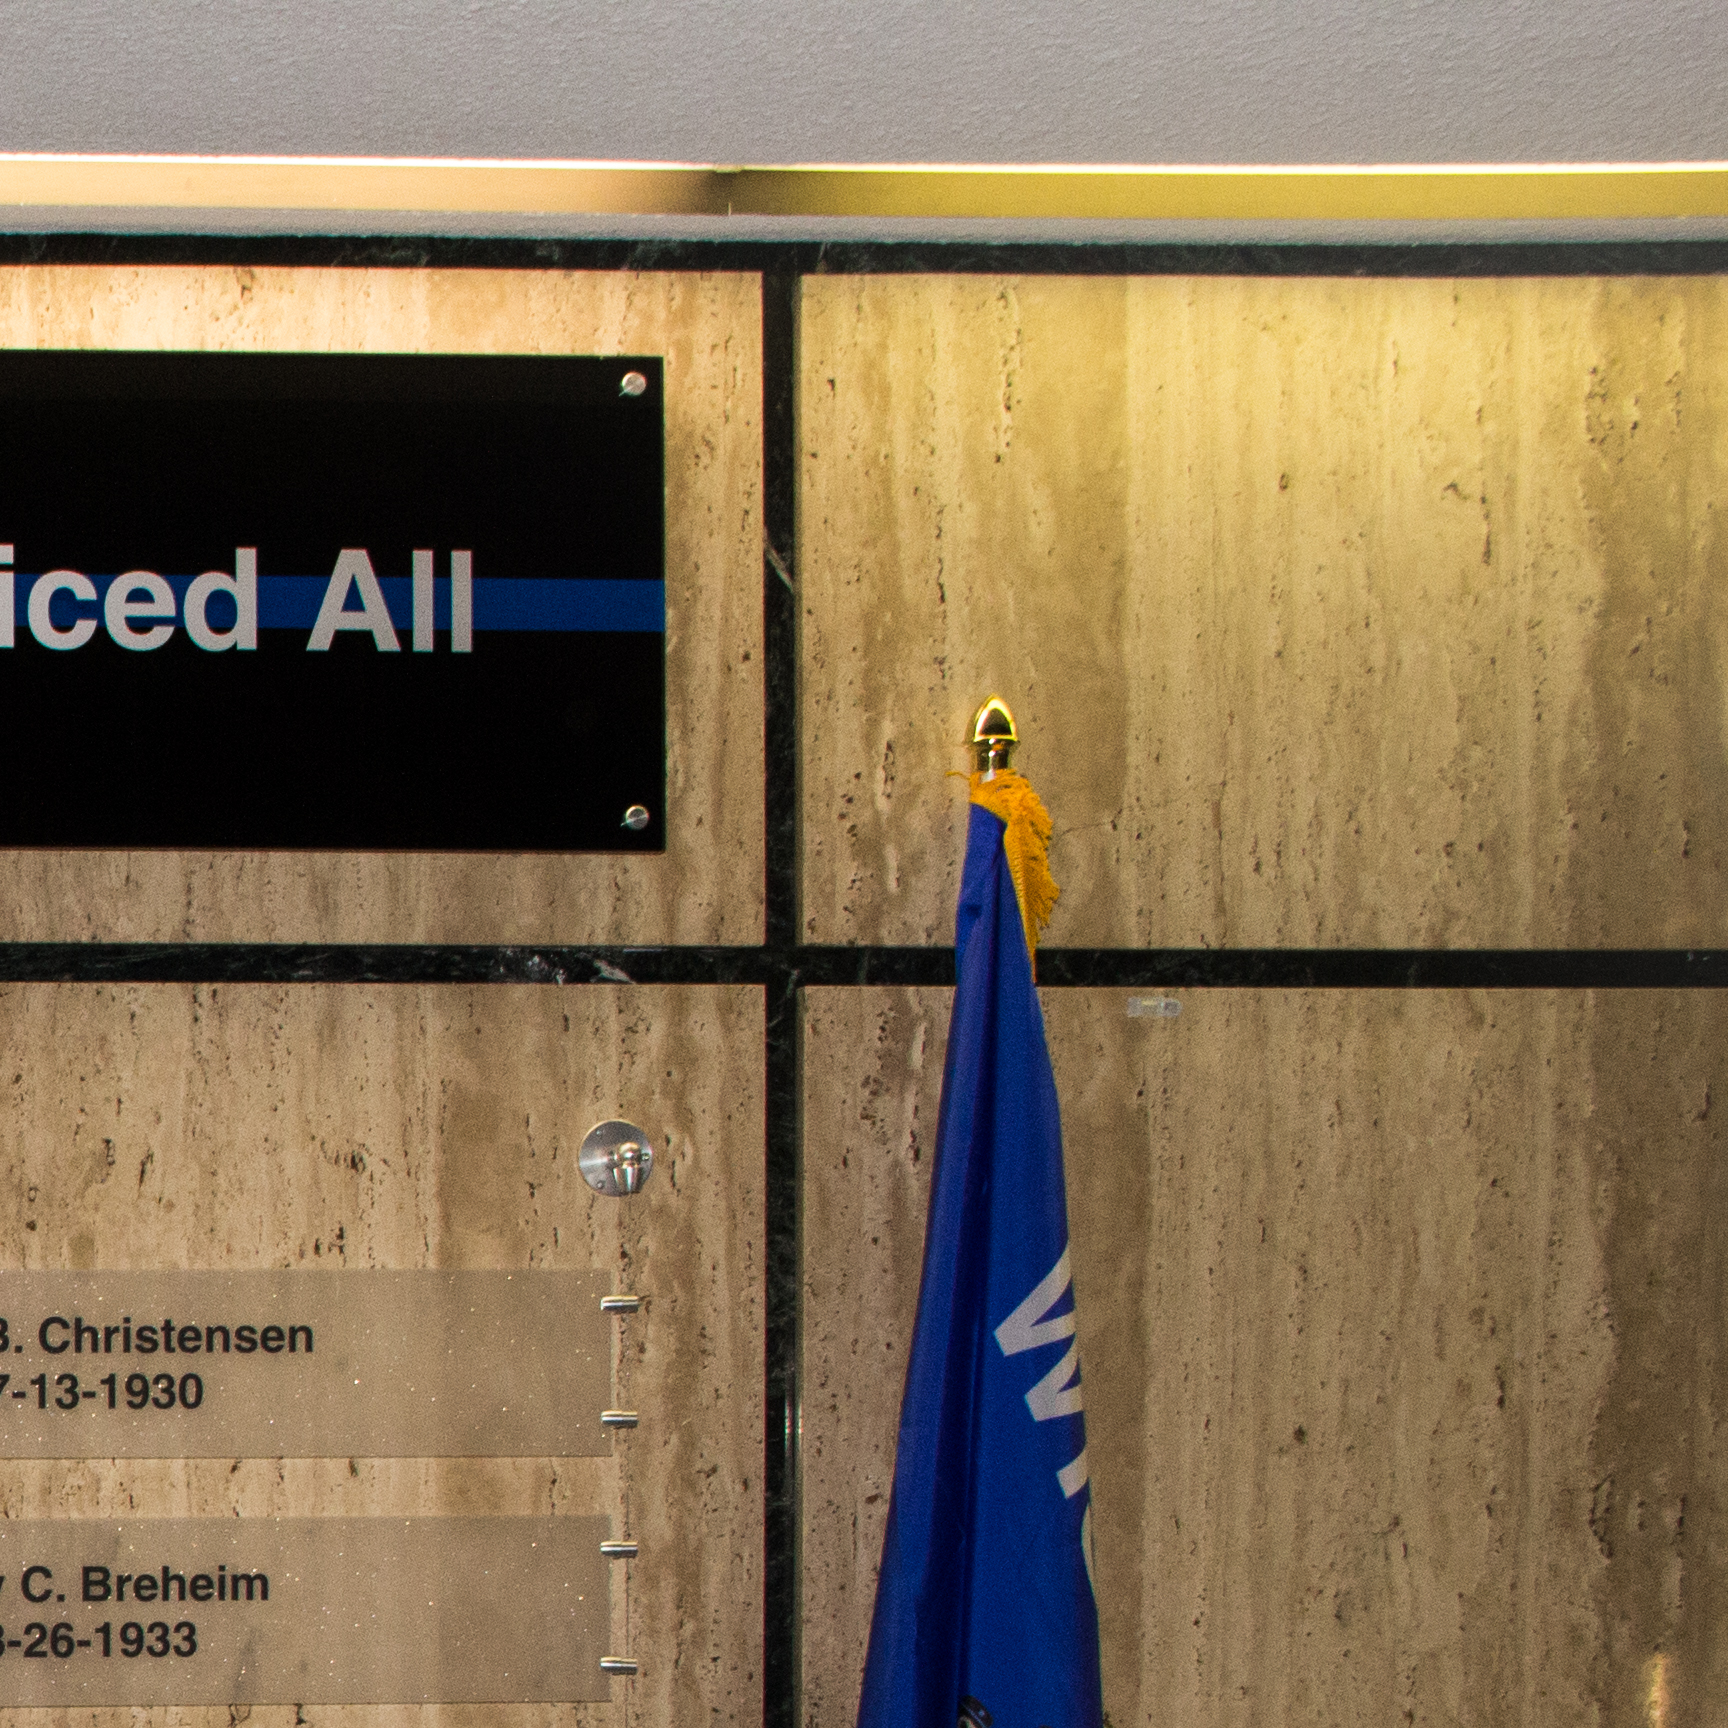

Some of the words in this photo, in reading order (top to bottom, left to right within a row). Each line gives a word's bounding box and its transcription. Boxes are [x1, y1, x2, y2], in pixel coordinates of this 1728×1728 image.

[308, 550, 471, 651] All
[39, 1317, 313, 1354] Christensen
[21, 1566, 65, 1603] C.
[82, 1566, 268, 1602] Breheim
